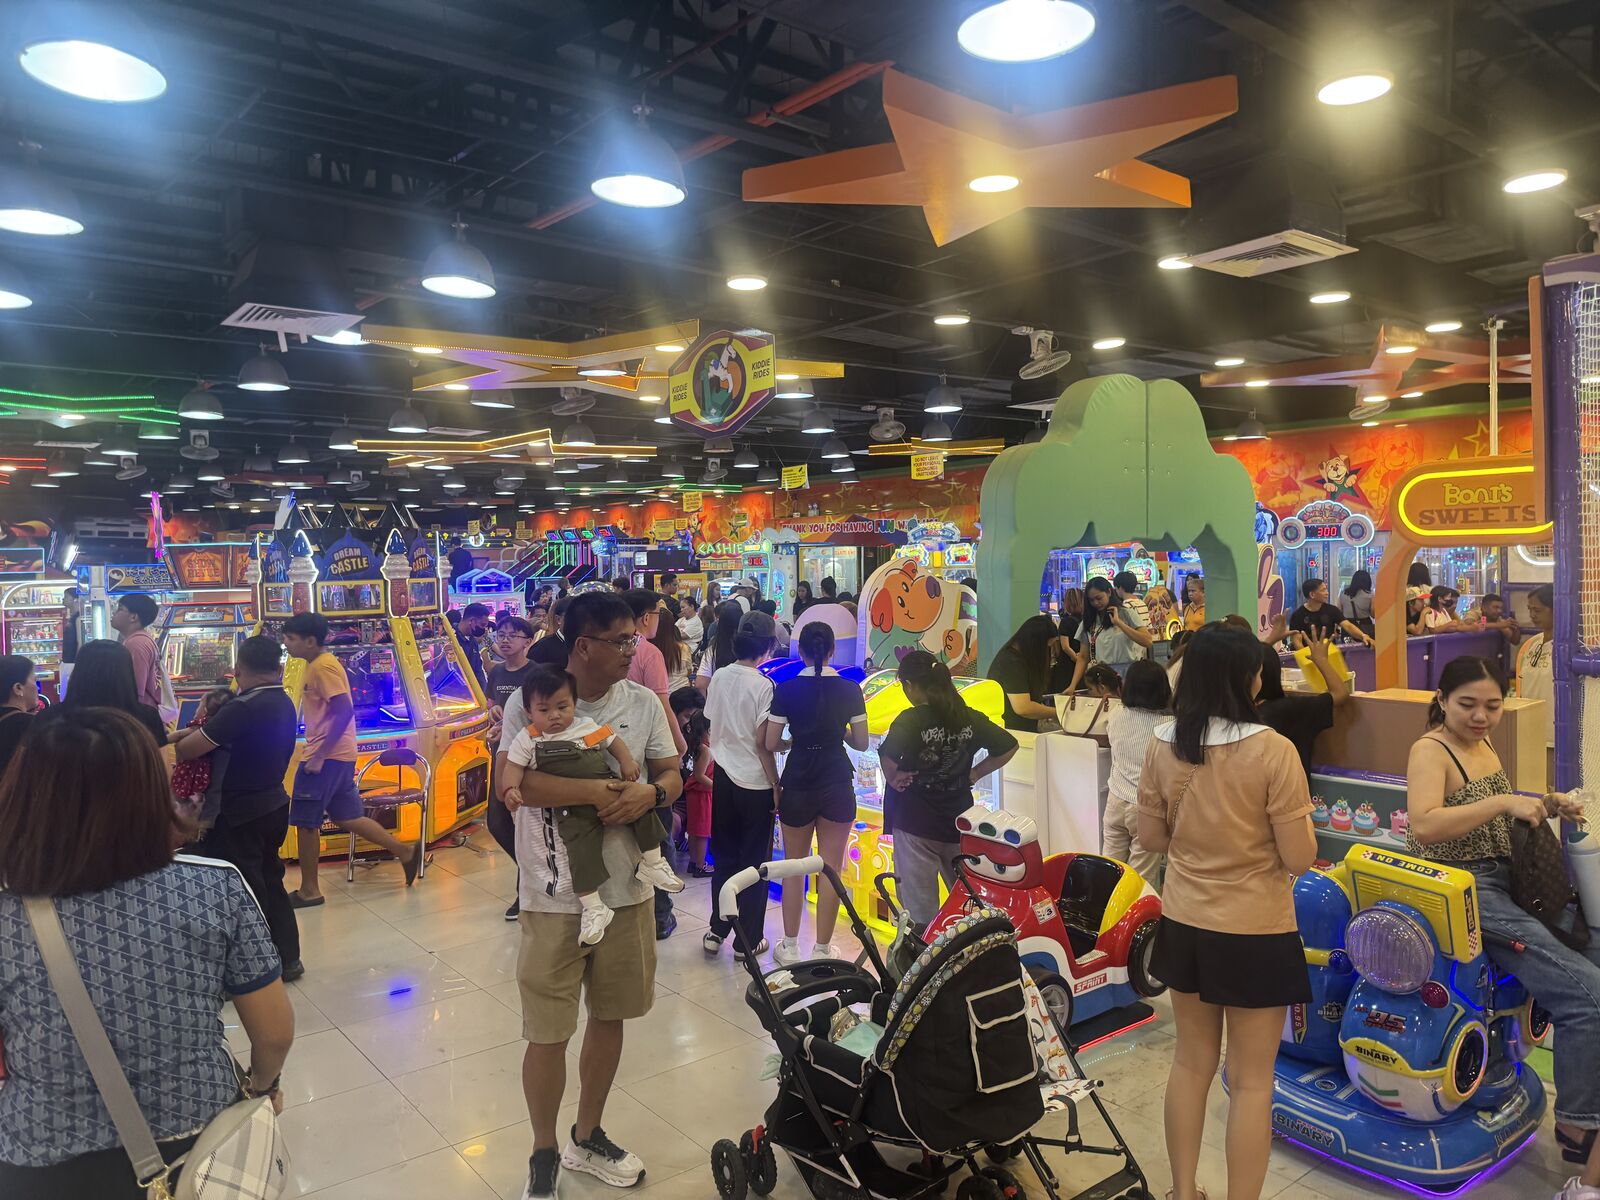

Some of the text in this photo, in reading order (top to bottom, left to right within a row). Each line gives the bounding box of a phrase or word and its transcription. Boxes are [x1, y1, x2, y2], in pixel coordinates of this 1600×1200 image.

[751, 358, 771, 371] KIDDIE
[752, 368, 770, 380] RIDES
[671, 382, 688, 395] KIDDIE
[672, 392, 688, 402] RIDES
[1419, 504, 1536, 526] SWEETS
[808, 523, 825, 533] YOU
[826, 522, 842, 532] FOR
[843, 521, 873, 533] HAVING
[874, 518, 896, 534] FUN
[1317, 526, 1338, 537] 300
[333, 547, 362, 562] DREAM
[699, 543, 744, 555] CASHIE
[330, 557, 369, 575] CASTLE
[412, 557, 430, 573] CASTLE
[1107, 568, 1115, 580] 2
[1144, 568, 1152, 580] 2
[1376, 854, 1434, 876] COME ON
[1046, 908, 1053, 916] 3
[1075, 974, 1106, 993] SPRINT
[1355, 1045, 1398, 1064] BINARY
[1275, 1111, 1335, 1148] BINARY
